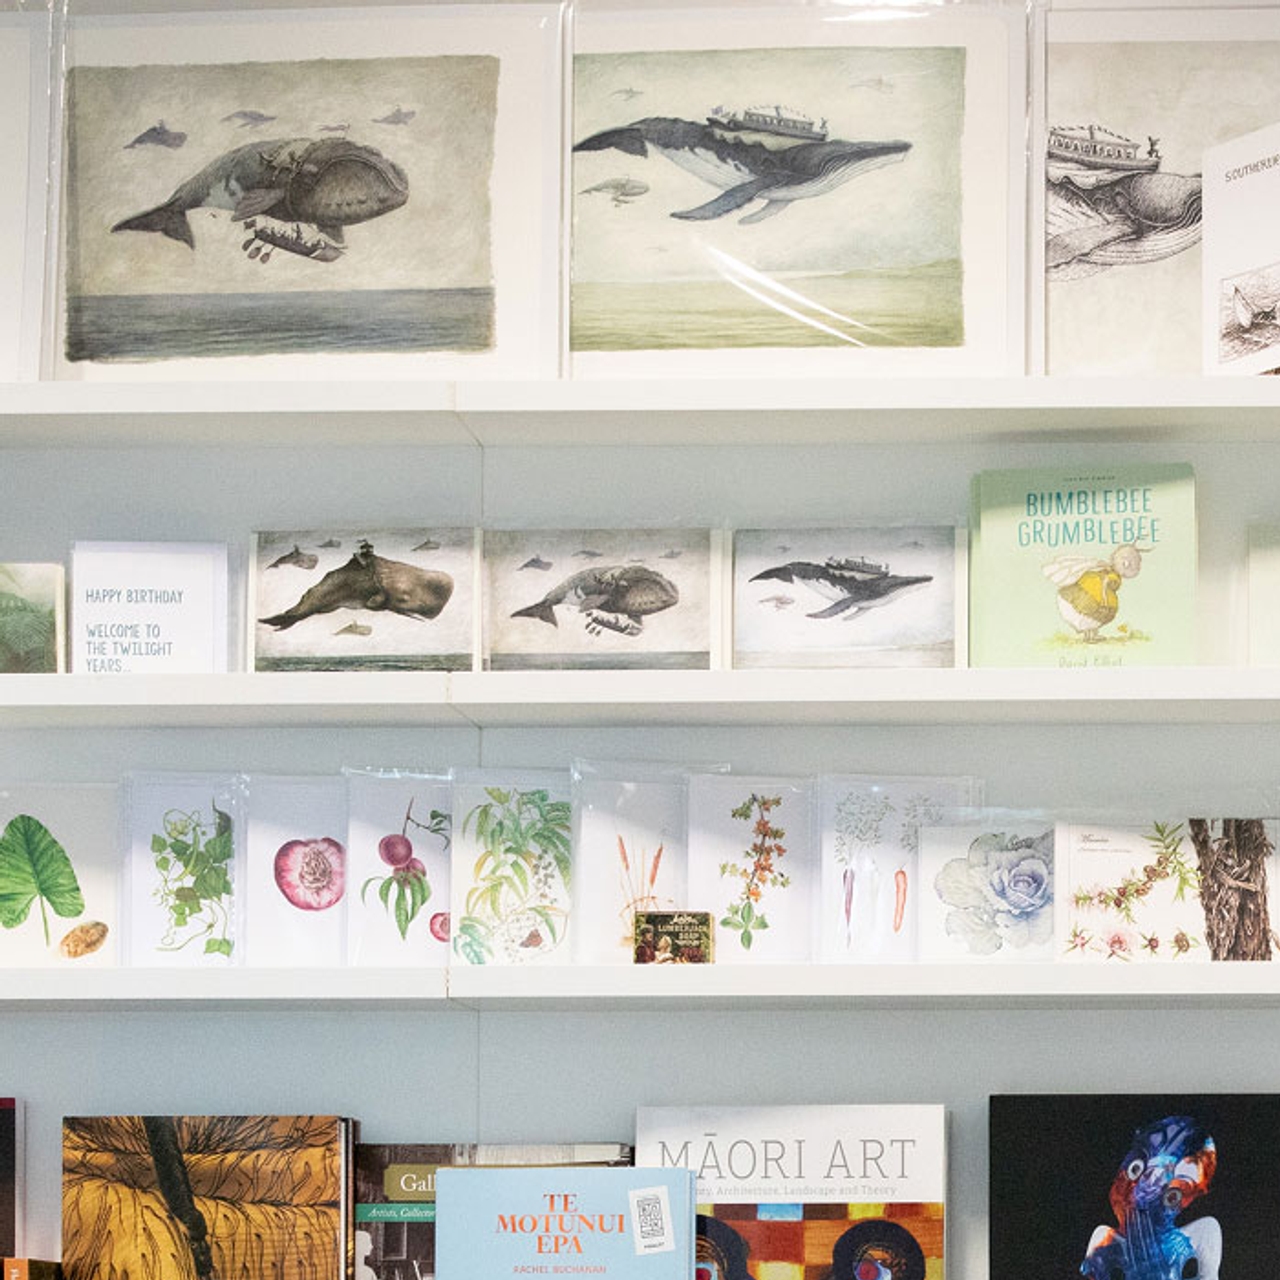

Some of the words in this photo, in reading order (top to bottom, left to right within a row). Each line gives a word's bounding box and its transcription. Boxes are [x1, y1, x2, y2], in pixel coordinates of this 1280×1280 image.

[1026, 488, 1153, 517] BUMBLEBEE
[1018, 516, 1161, 548] GRUMBLEBEE
[86, 588, 121, 603] HAPPY
[126, 589, 184, 604] BIRTHDAY
[86, 623, 140, 638] WELCOME
[146, 624, 161, 639] TO
[86, 642, 107, 656] THE
[112, 642, 173, 656] TWILIGHT
[658, 1132, 805, 1179] MĀORI
[823, 1139, 916, 1179] ART
[544, 1193, 578, 1213] TE
[496, 1214, 625, 1234] MOTUNUI
[536, 1236, 583, 1254] EPA
[513, 1265, 549, 1274] RACHEL
[553, 1265, 607, 1274] BUCHANAN
